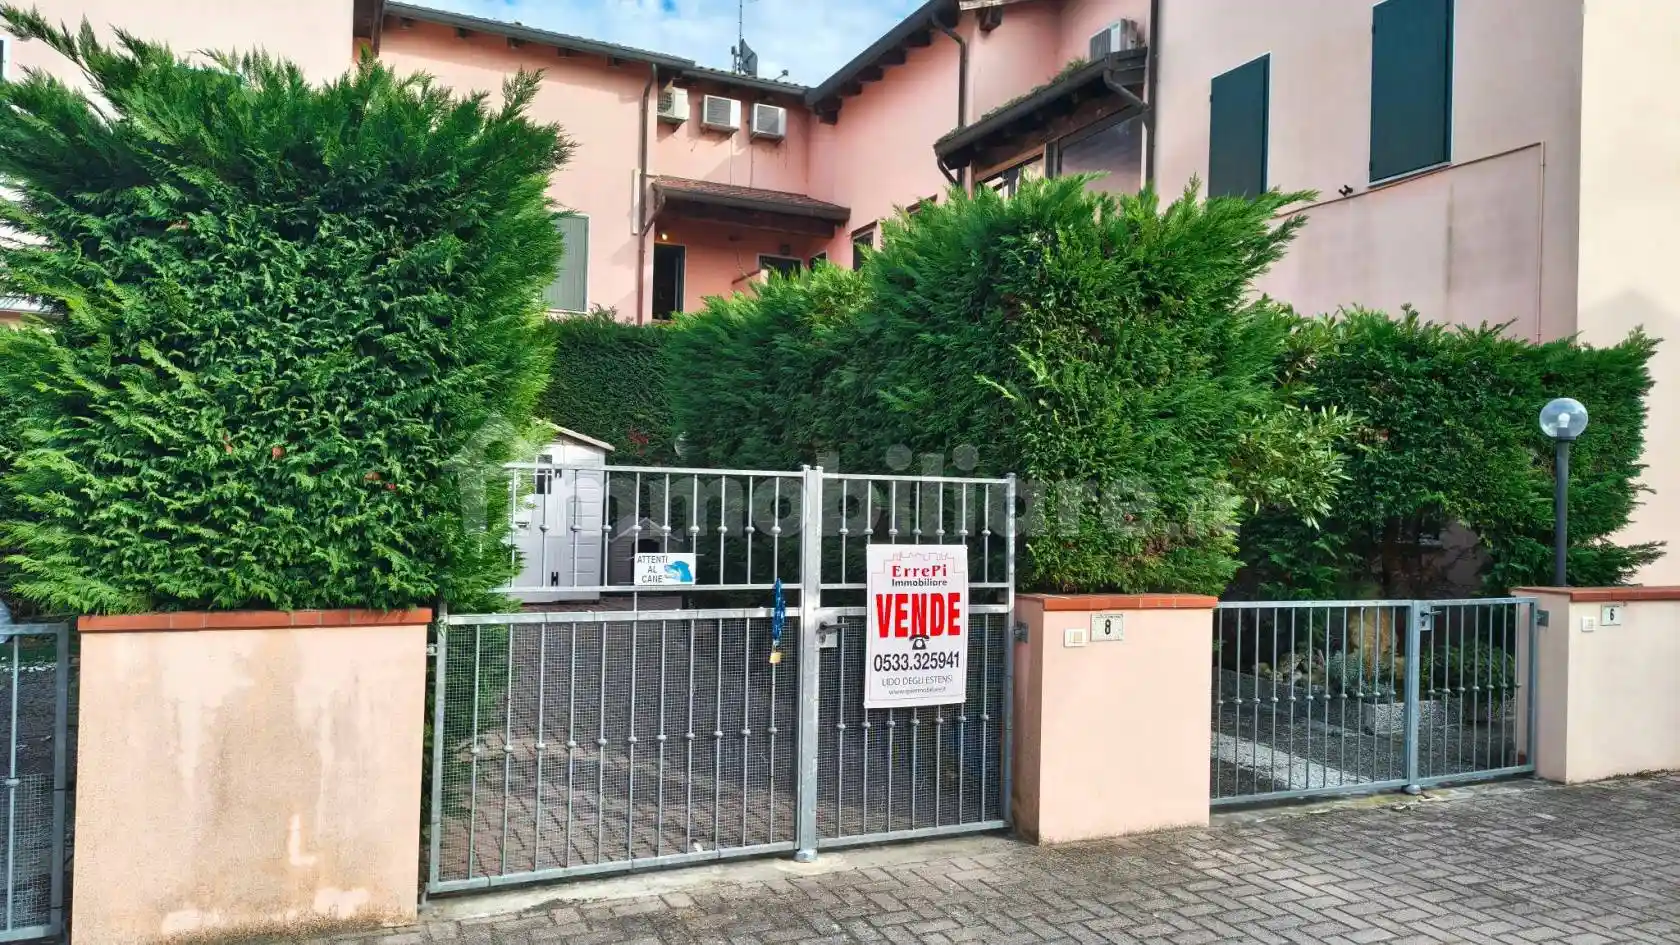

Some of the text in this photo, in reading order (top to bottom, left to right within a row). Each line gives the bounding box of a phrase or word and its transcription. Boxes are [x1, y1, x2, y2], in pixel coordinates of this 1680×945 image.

[637, 555, 668, 563] ATTENTI
[647, 565, 657, 573] AL
[891, 564, 948, 577] ErrePi
[641, 574, 663, 583] CANE
[891, 577, 948, 587] Immobiliare
[875, 592, 961, 638] VENDE
[1609, 607, 1615, 621] 6
[1104, 618, 1112, 635] 8
[873, 651, 960, 672] 0533.325941
[881, 674, 953, 687] LIDO DEGLI ESTENSI
